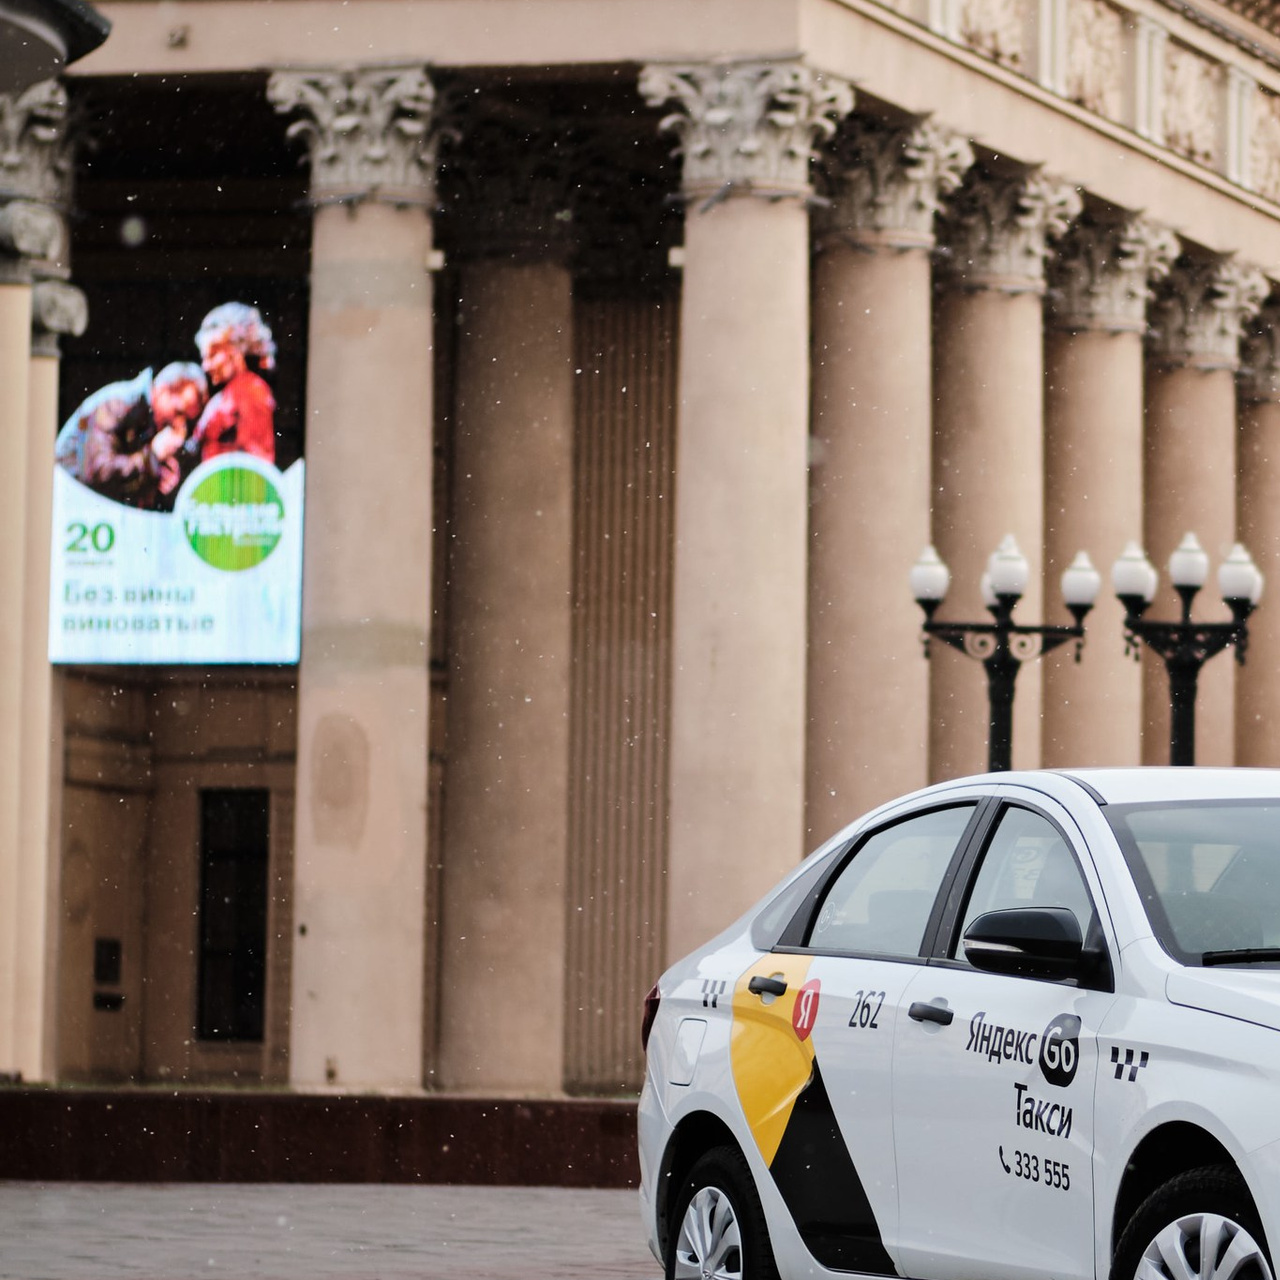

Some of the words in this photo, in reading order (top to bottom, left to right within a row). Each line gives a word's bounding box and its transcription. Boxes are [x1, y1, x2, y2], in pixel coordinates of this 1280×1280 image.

[66, 523, 115, 552] 20
[796, 989, 815, 1029] Я
[848, 990, 886, 1029] 262
[966, 1012, 1037, 1065] Яндекс
[1043, 1026, 1075, 1073] Go
[1014, 1082, 1073, 1139] Такси
[1014, 1150, 1040, 1182] 333
[1044, 1158, 1070, 1191] 555
